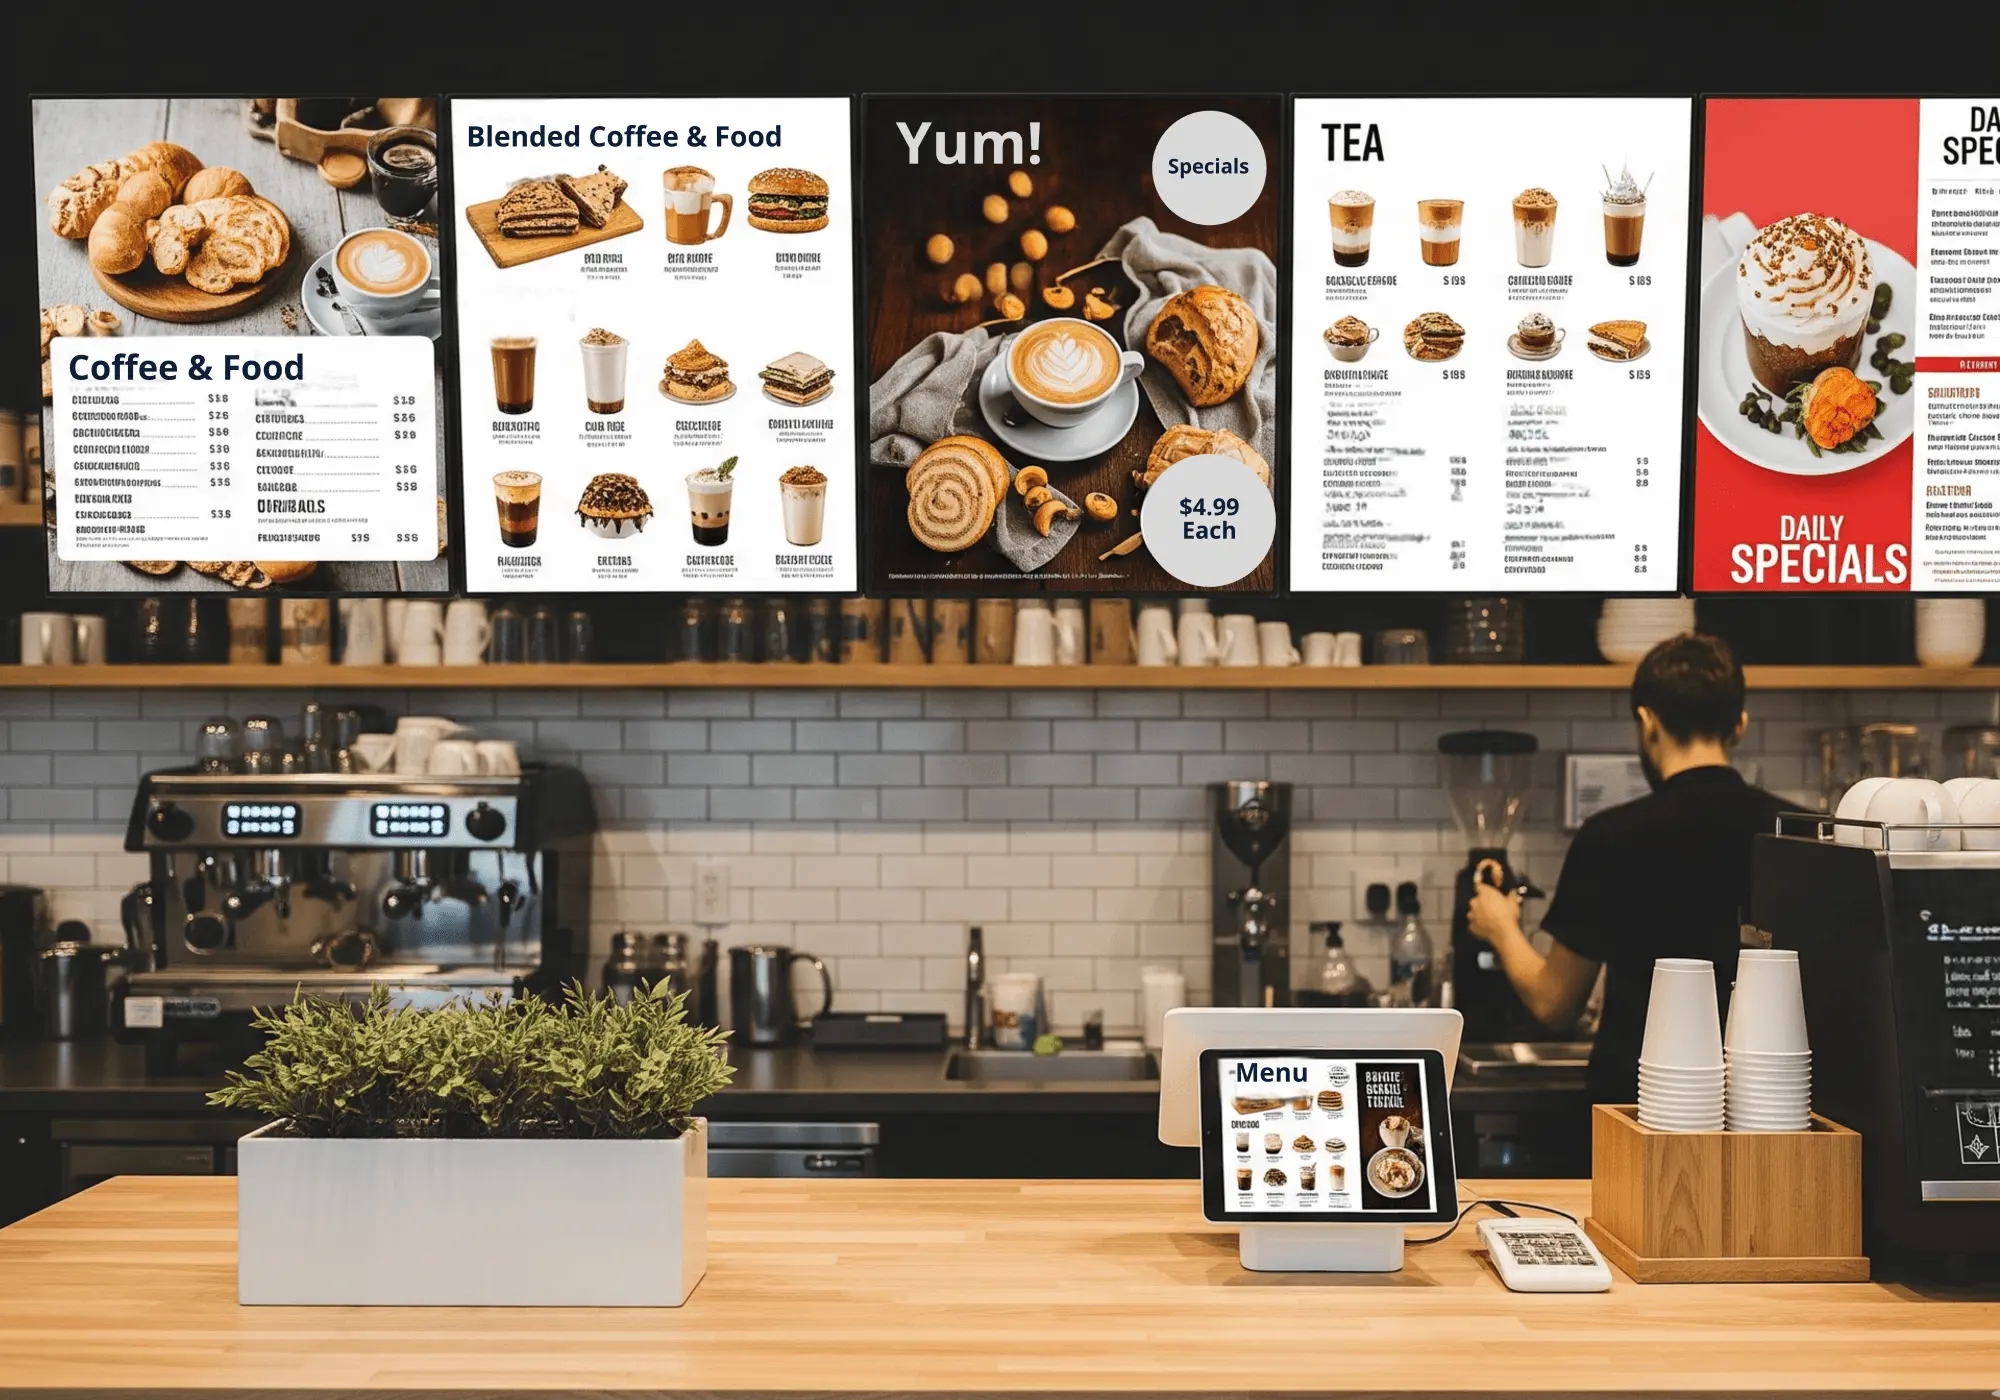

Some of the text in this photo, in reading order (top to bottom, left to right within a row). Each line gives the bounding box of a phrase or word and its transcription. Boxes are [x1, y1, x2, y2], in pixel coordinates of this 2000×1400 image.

[469, 125, 781, 147] Blended Coffee & Food
[896, 122, 1040, 165] Yum!
[1321, 123, 1384, 161] TEA
[1944, 136, 2000, 165] SPE
[1169, 158, 1248, 178] Specials
[70, 353, 303, 380] Coffee & Food
[1180, 497, 1239, 522] $4.99
[1184, 521, 1235, 539] Each
[1781, 515, 1844, 544] DAILY
[1731, 543, 1907, 584] SPECIALS
[1237, 1063, 1307, 1082] Menu
